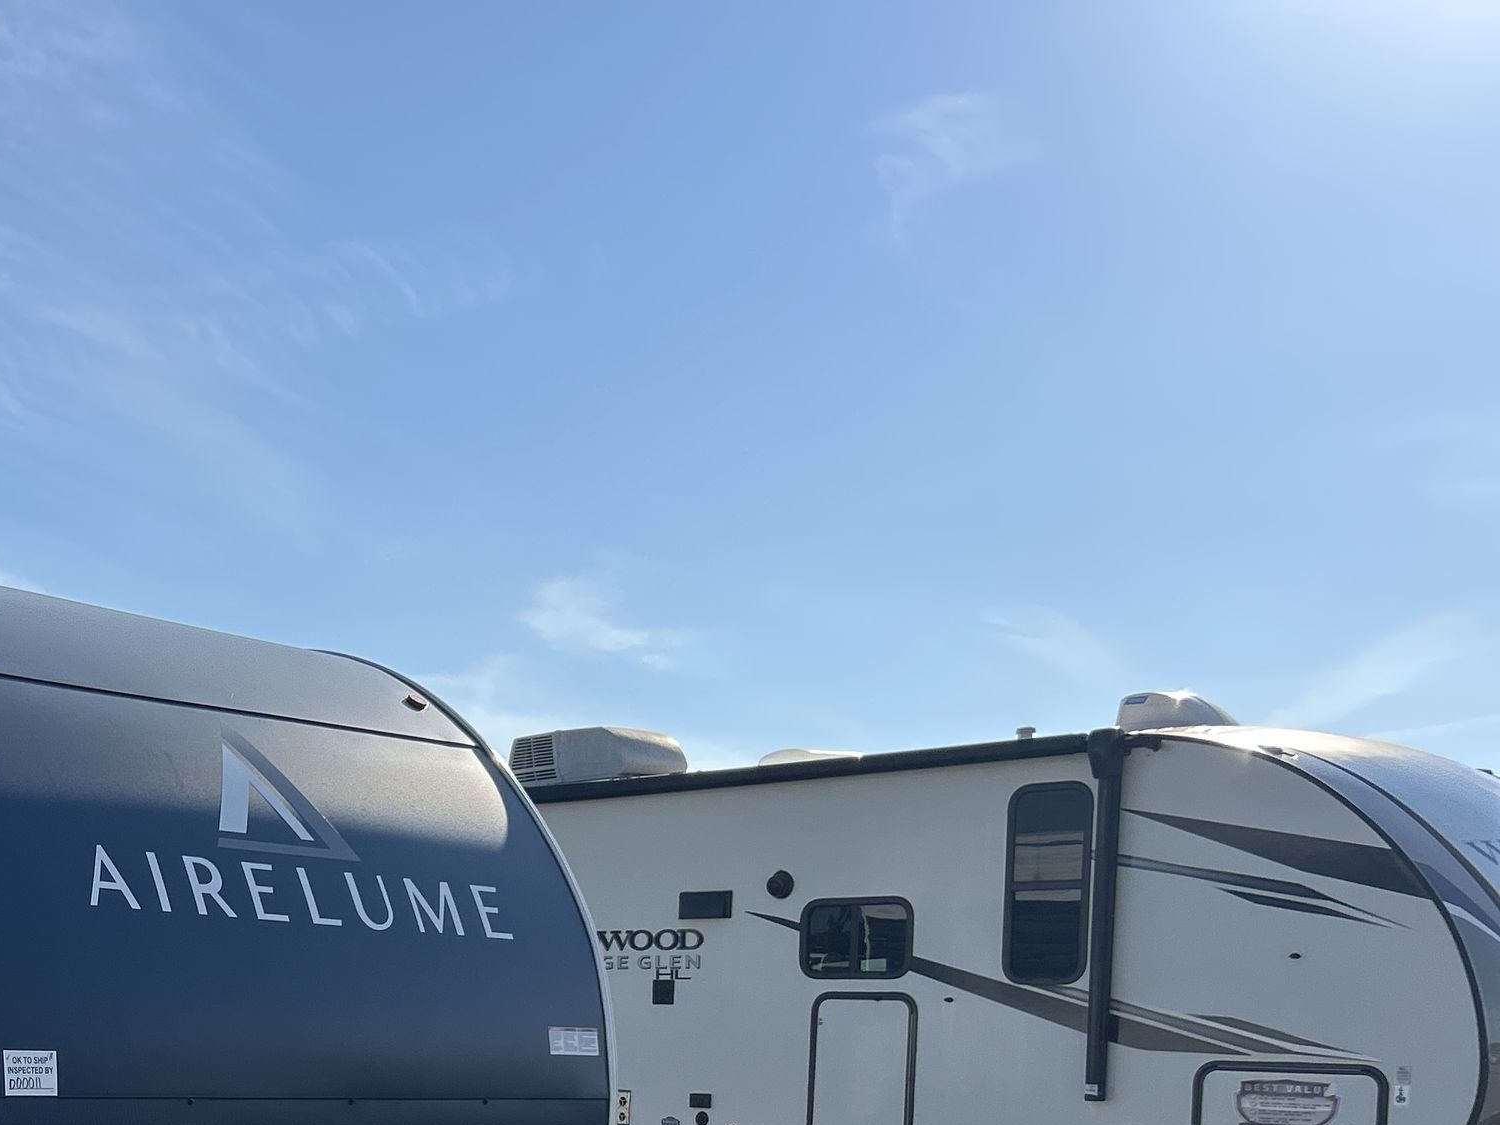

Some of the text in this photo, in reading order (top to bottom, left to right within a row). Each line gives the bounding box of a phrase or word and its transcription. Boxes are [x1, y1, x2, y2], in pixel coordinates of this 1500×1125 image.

[90, 844, 515, 940] AIRELUME
[597, 929, 704, 951] WOOD
[637, 954, 701, 970] GLEN
[12, 1056, 48, 1064] OK TO SHIP
[7, 1066, 43, 1074] INSPECTED
